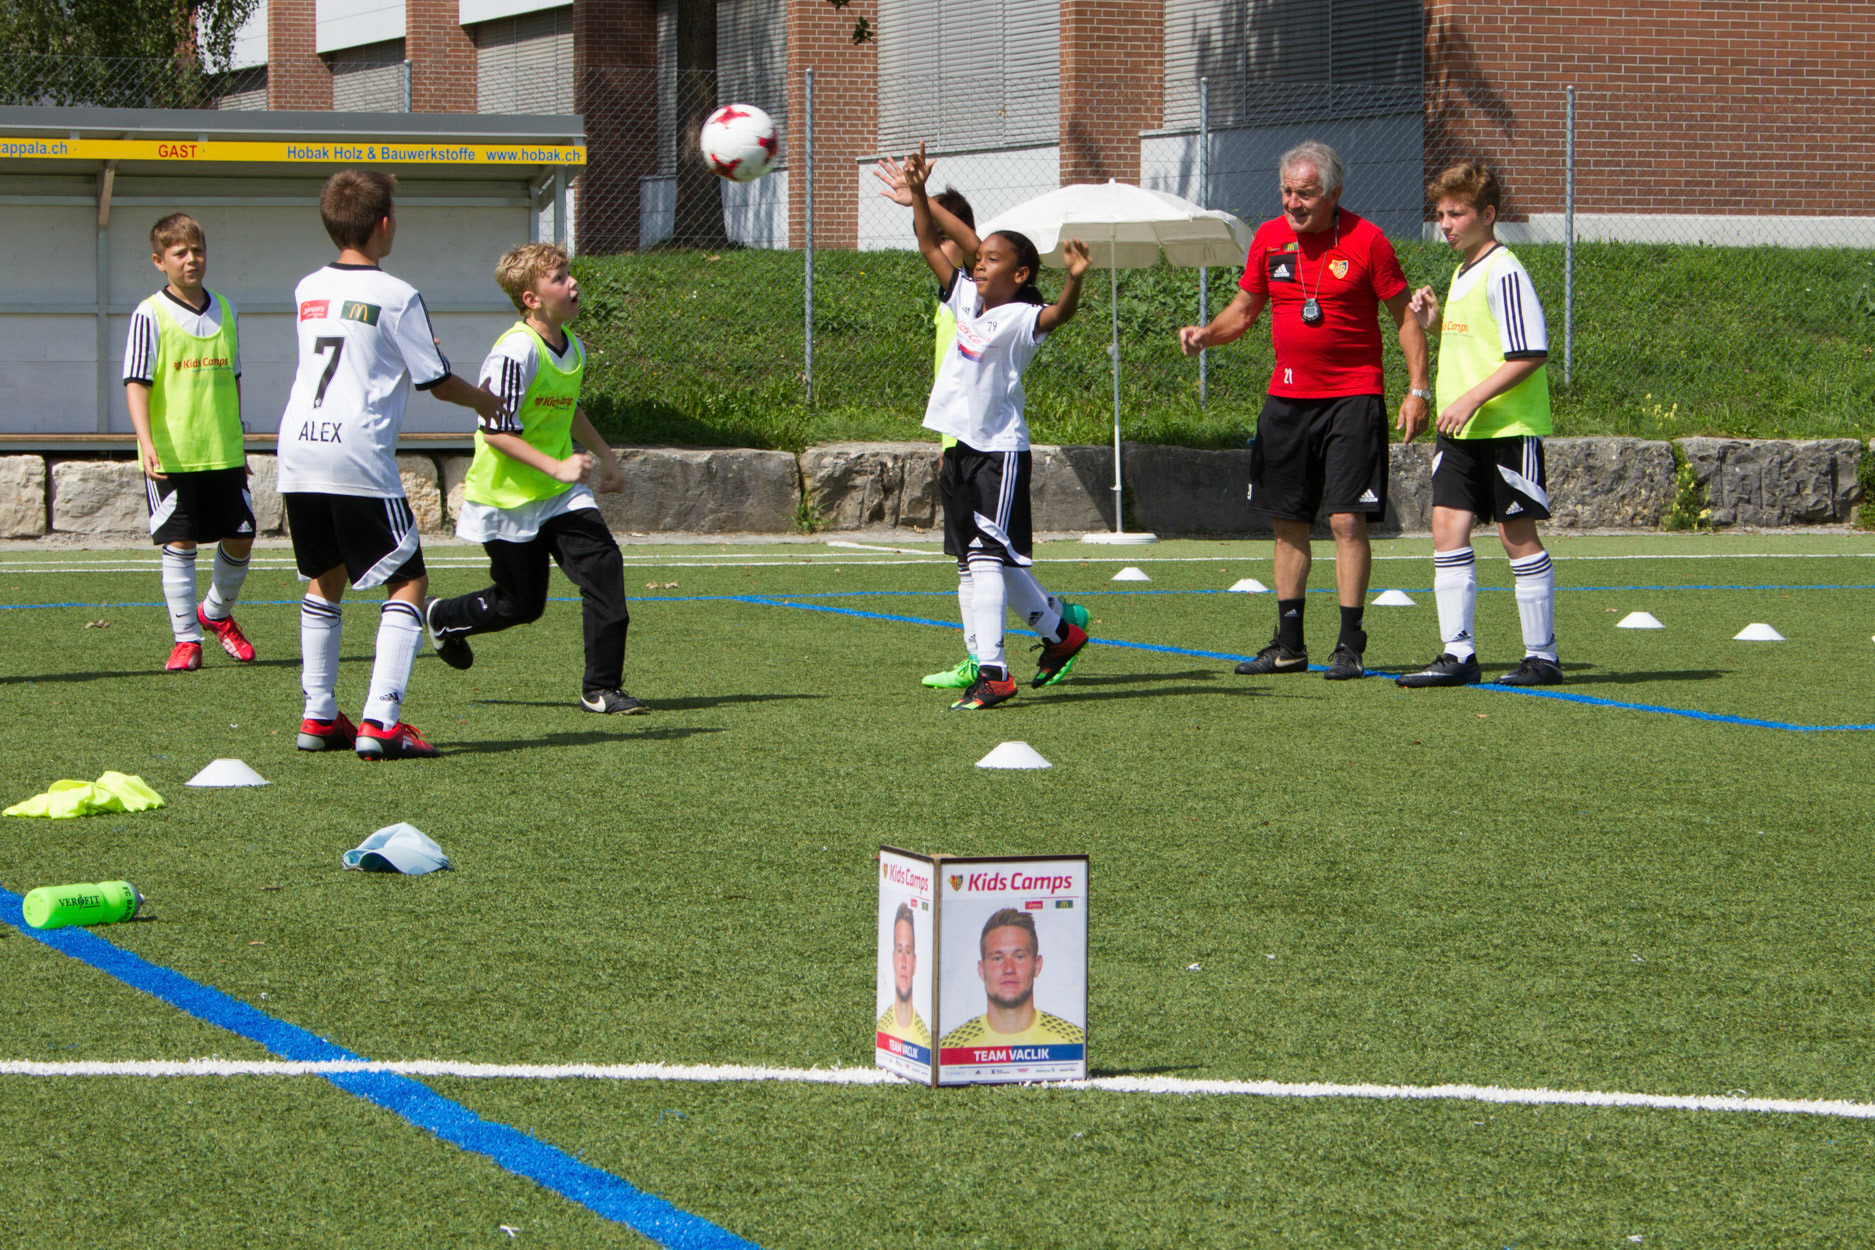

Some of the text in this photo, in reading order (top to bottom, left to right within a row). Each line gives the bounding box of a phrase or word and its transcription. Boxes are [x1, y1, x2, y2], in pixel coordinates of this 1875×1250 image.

[0, 141, 68, 158] appala.ch
[158, 144, 198, 158] GAST
[287, 146, 581, 162] Hobak Holz & Bauwerkstoffe www.hobak.ch
[988, 321, 998, 332] 79
[183, 357, 229, 369] Kids Camps
[314, 337, 345, 409] 7
[298, 420, 343, 443] ALEX
[890, 864, 929, 895] Kids Camps
[968, 872, 1072, 895] Kids Camps
[59, 894, 100, 908] VEROFIT
[889, 1039, 903, 1055] TEAM
[974, 1048, 1050, 1062] TEAM VACLIK
